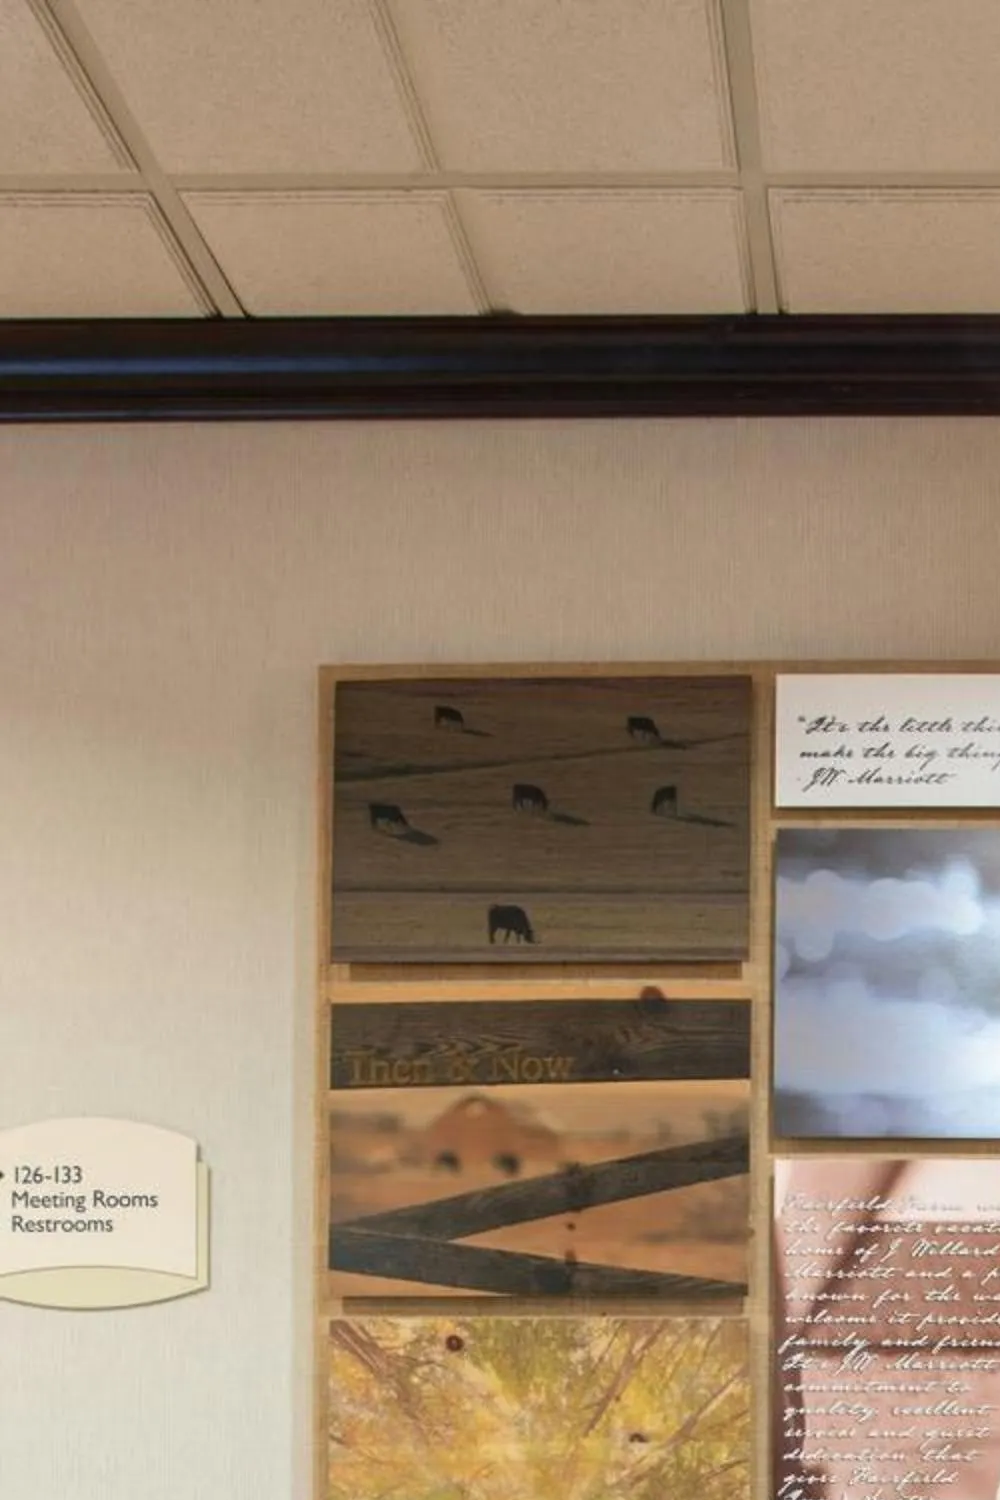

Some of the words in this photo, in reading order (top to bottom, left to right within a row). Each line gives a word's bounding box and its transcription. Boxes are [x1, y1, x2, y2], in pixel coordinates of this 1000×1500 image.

[858, 715, 890, 733] the
[900, 716, 953, 733] little
[800, 744, 853, 759] make
[863, 741, 895, 759] the
[904, 743, 940, 771] big
[848, 766, 957, 785] Marriott
[347, 1050, 432, 1085] Then
[491, 1047, 577, 1082] Now
[14, 1165, 83, 1184] 126-133
[11, 1191, 86, 1213] Meeting
[93, 1190, 158, 1208] Rooms
[11, 1215, 113, 1233] Restrooms
[824, 1220, 923, 1241] favorite
[785, 1239, 844, 1256] home
[854, 1243, 880, 1263] of
[911, 1238, 1000, 1258] Willard
[784, 1263, 903, 1279] Marriott
[904, 1267, 953, 1279] and
[961, 1270, 976, 1279] a
[785, 1288, 870, 1302] known
[873, 1288, 911, 1309] for
[924, 1284, 961, 1302] the
[785, 1309, 877, 1324] welcome
[888, 1310, 920, 1324] it
[778, 1332, 869, 1357] family
[881, 1335, 928, 1347] and
[784, 1381, 940, 1394] commitment
[891, 1400, 999, 1417] excellent
[867, 1426, 916, 1438] and
[921, 1444, 981, 1462] that
